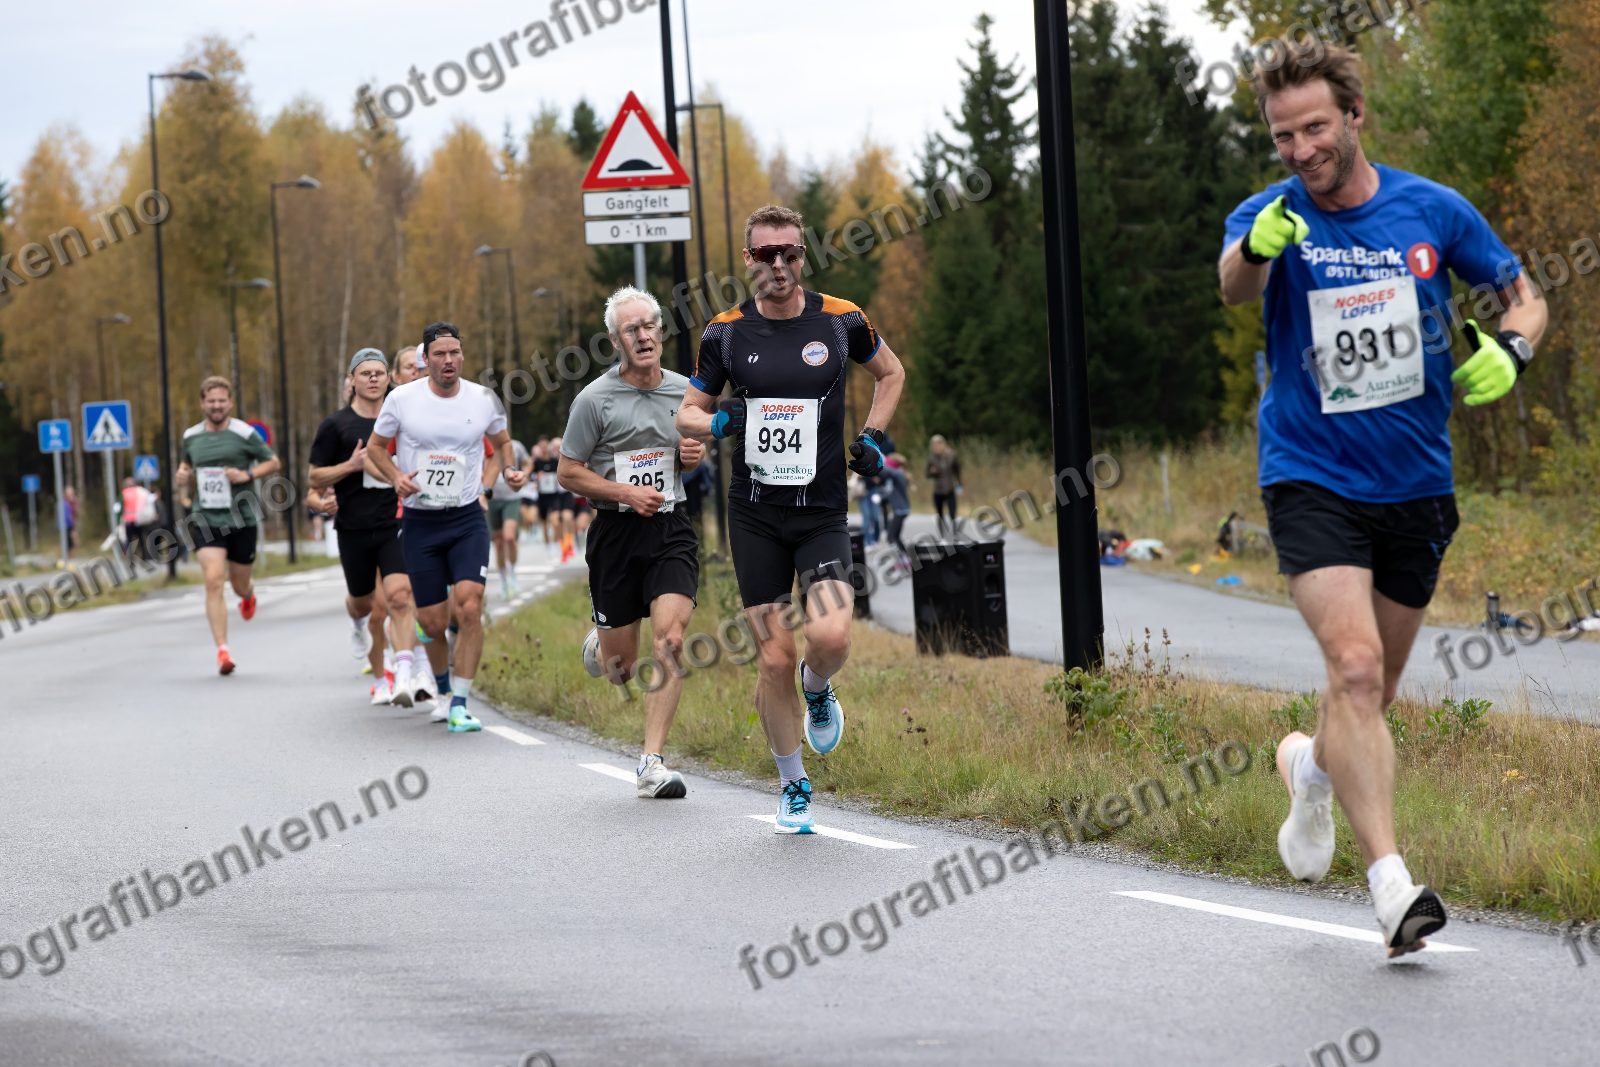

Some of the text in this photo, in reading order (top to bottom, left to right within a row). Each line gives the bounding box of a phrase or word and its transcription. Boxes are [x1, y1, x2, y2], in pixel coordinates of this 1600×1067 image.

[605, 195, 669, 212] Gangfelt
[610, 225, 620, 238] 0
[636, 225, 641, 237] 1
[646, 224, 667, 236] km
[1300, 240, 1430, 273] SpareBank 1
[1325, 265, 1407, 280] ØSTLANDET
[1334, 288, 1395, 308] NORGES
[1341, 302, 1386, 320] LØPET
[1336, 323, 1396, 365] 931
[1366, 373, 1420, 393] Aurskog
[760, 404, 804, 413] NORGES
[763, 413, 797, 421] LØPET
[758, 427, 802, 454] 934
[628, 451, 665, 463] NORGES
[426, 469, 455, 487] 727
[772, 465, 813, 477] Aurskog
[202, 480, 224, 493] 492
